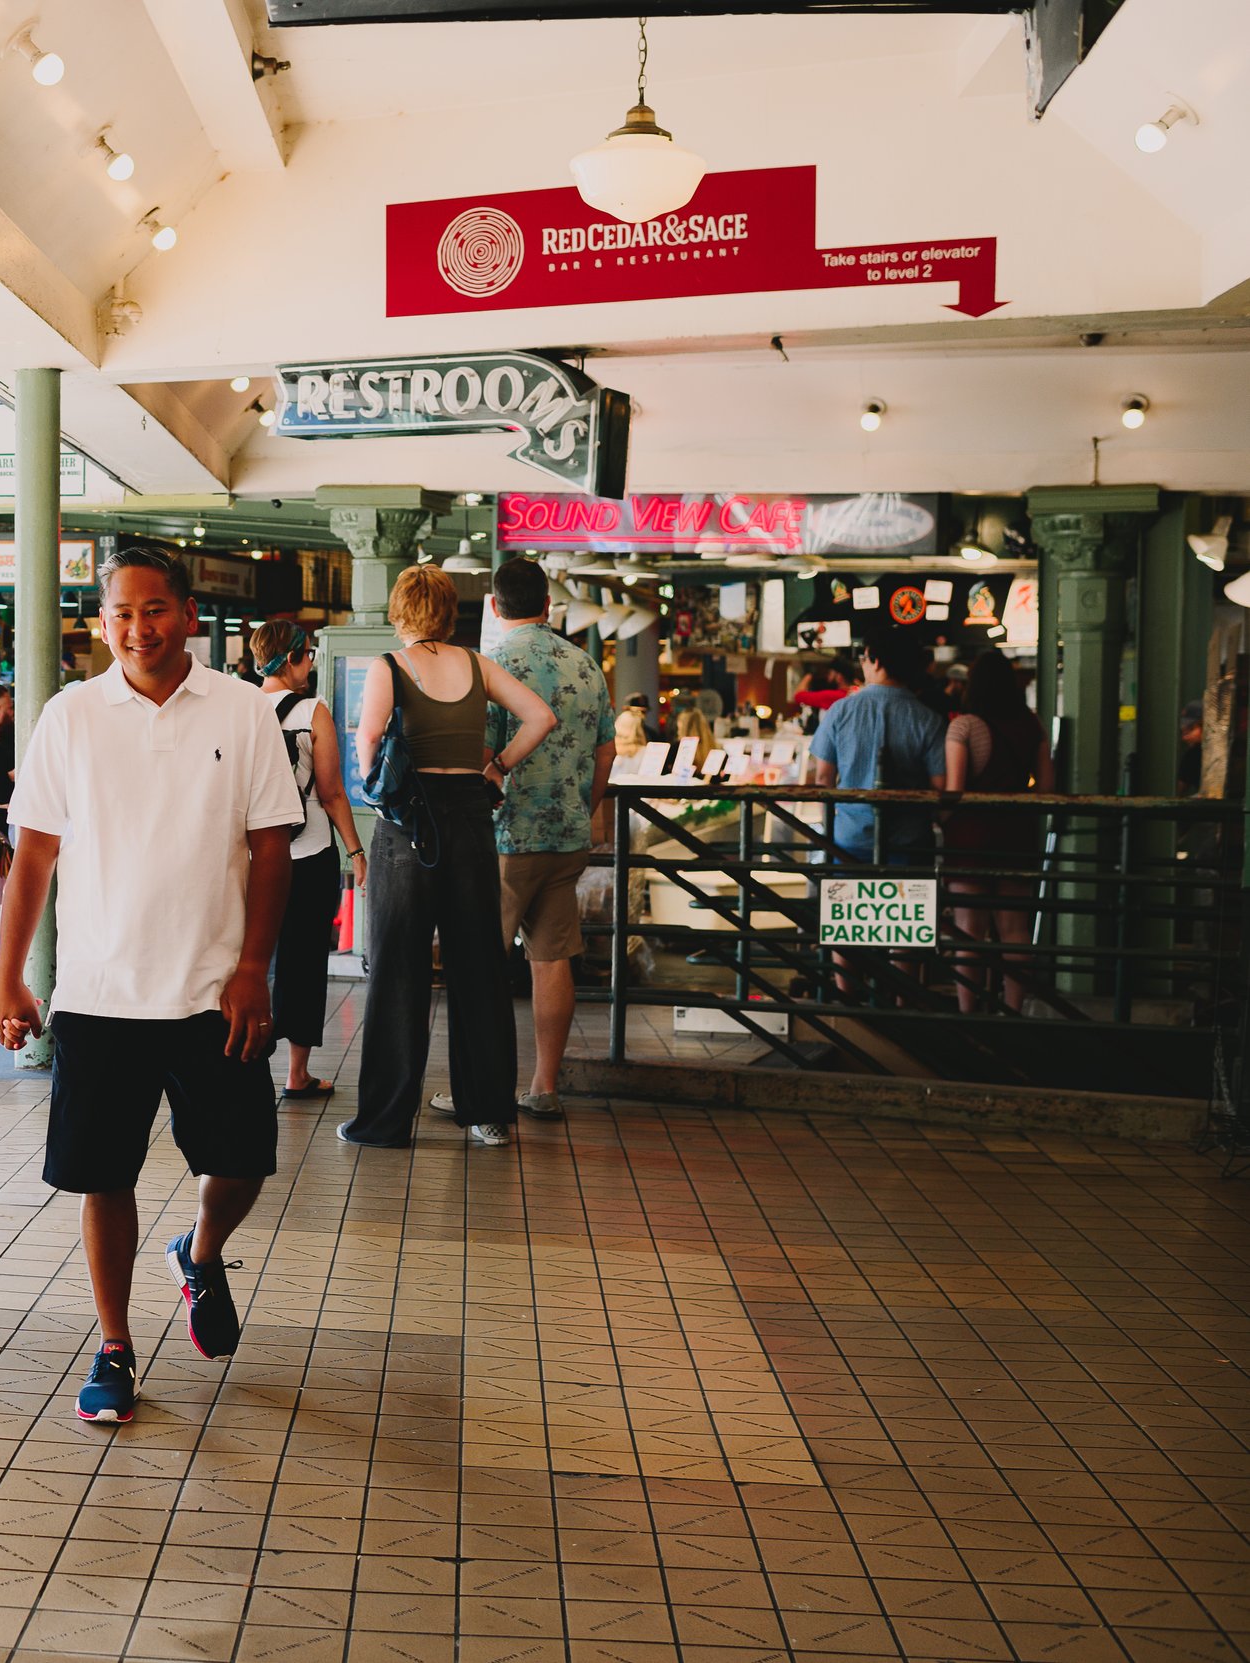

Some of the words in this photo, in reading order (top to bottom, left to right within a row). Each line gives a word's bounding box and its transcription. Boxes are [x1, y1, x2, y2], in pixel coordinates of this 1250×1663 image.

[548, 260, 580, 272] BAR
[616, 246, 740, 266] RESTAURANT
[821, 252, 856, 267] Take
[859, 250, 899, 264] stairs
[902, 250, 918, 262] or
[921, 245, 981, 261] elevator
[867, 268, 882, 281] to
[884, 265, 919, 280] level
[922, 264, 933, 278] 2
[296, 365, 590, 461] RESTROOMS
[503, 494, 621, 532] SOUND
[630, 498, 711, 533] VIEW
[857, 881, 899, 899] NO
[831, 903, 925, 921] BICYCLE
[821, 924, 934, 943] PARKING
